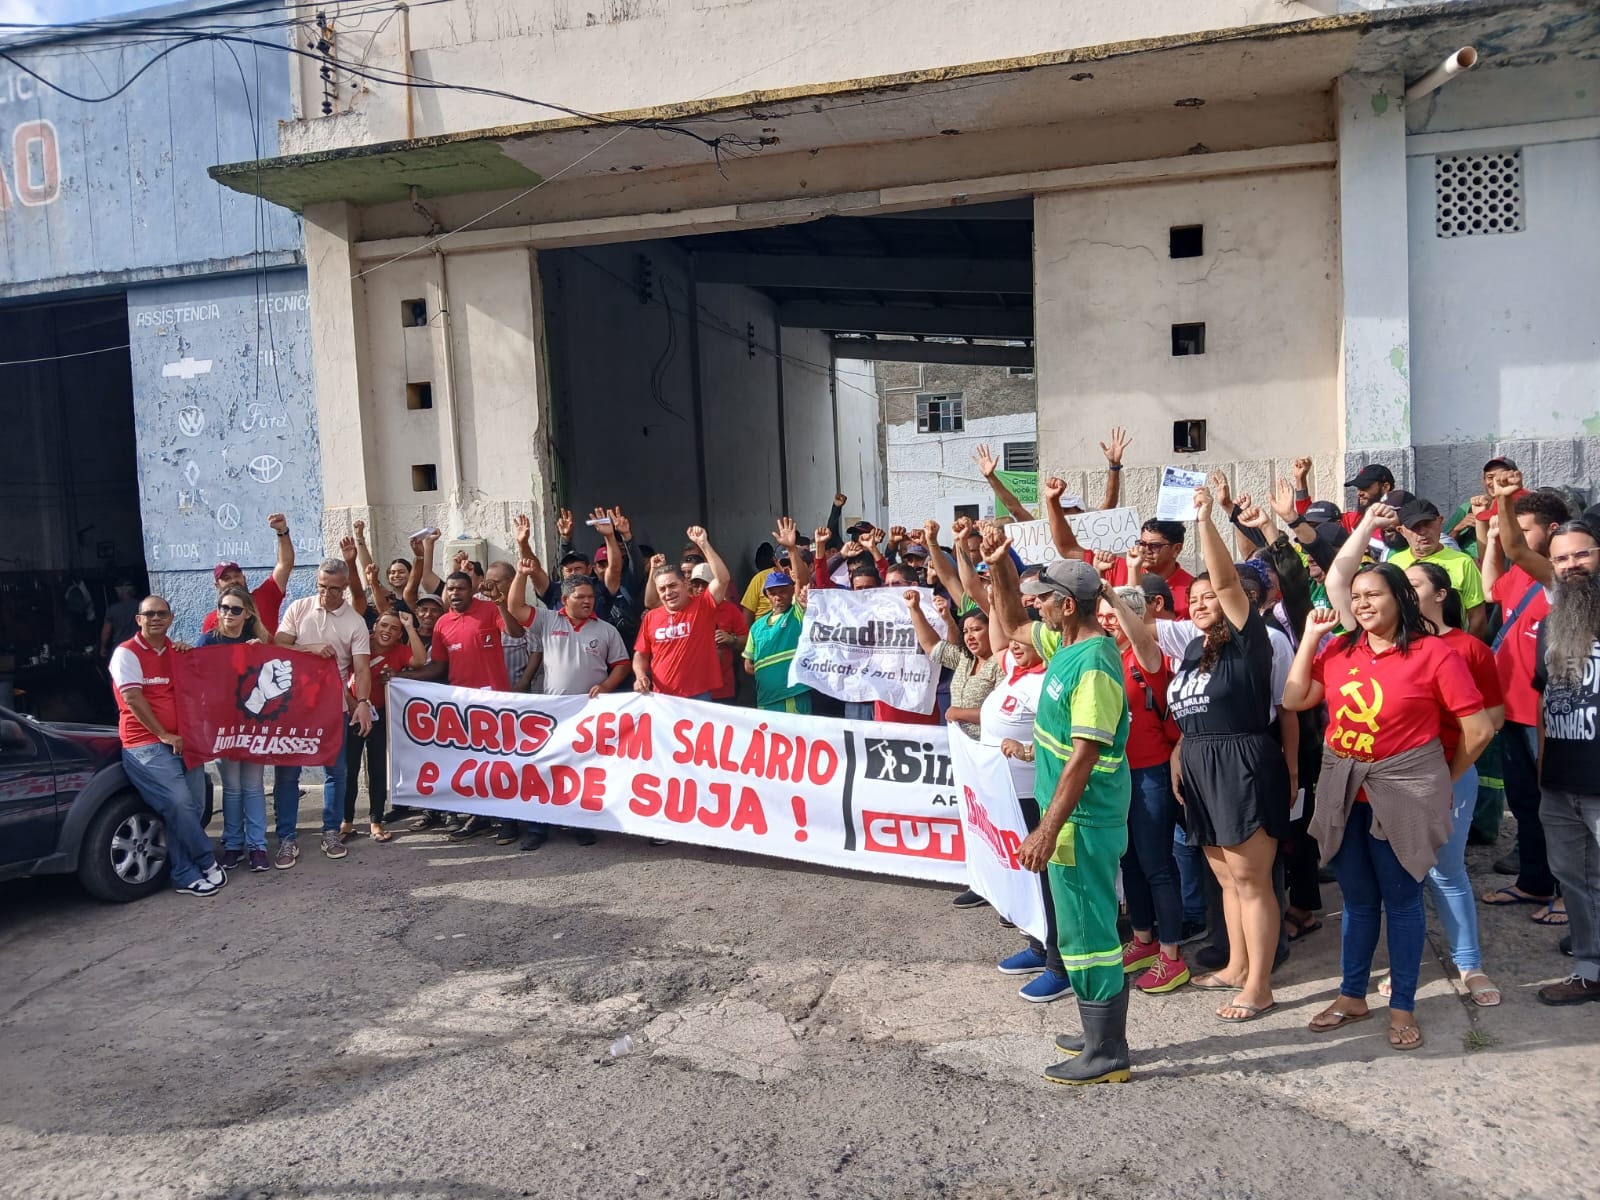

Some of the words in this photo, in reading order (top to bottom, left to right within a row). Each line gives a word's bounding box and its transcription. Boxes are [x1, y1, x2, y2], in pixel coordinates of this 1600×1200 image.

[168, 543, 199, 558] TODA
[216, 541, 253, 556] LINHA
[217, 724, 323, 737] MOVIMENTO
[404, 698, 555, 756] GARIS
[571, 711, 653, 762] SEM
[672, 719, 838, 786] SALÁRIO
[1330, 725, 1375, 753] PCR
[259, 735, 321, 755] CLASSES
[416, 761, 440, 796] e
[451, 759, 607, 811] CIDADE
[629, 773, 768, 836] SUJA
[869, 818, 959, 856] CUT
